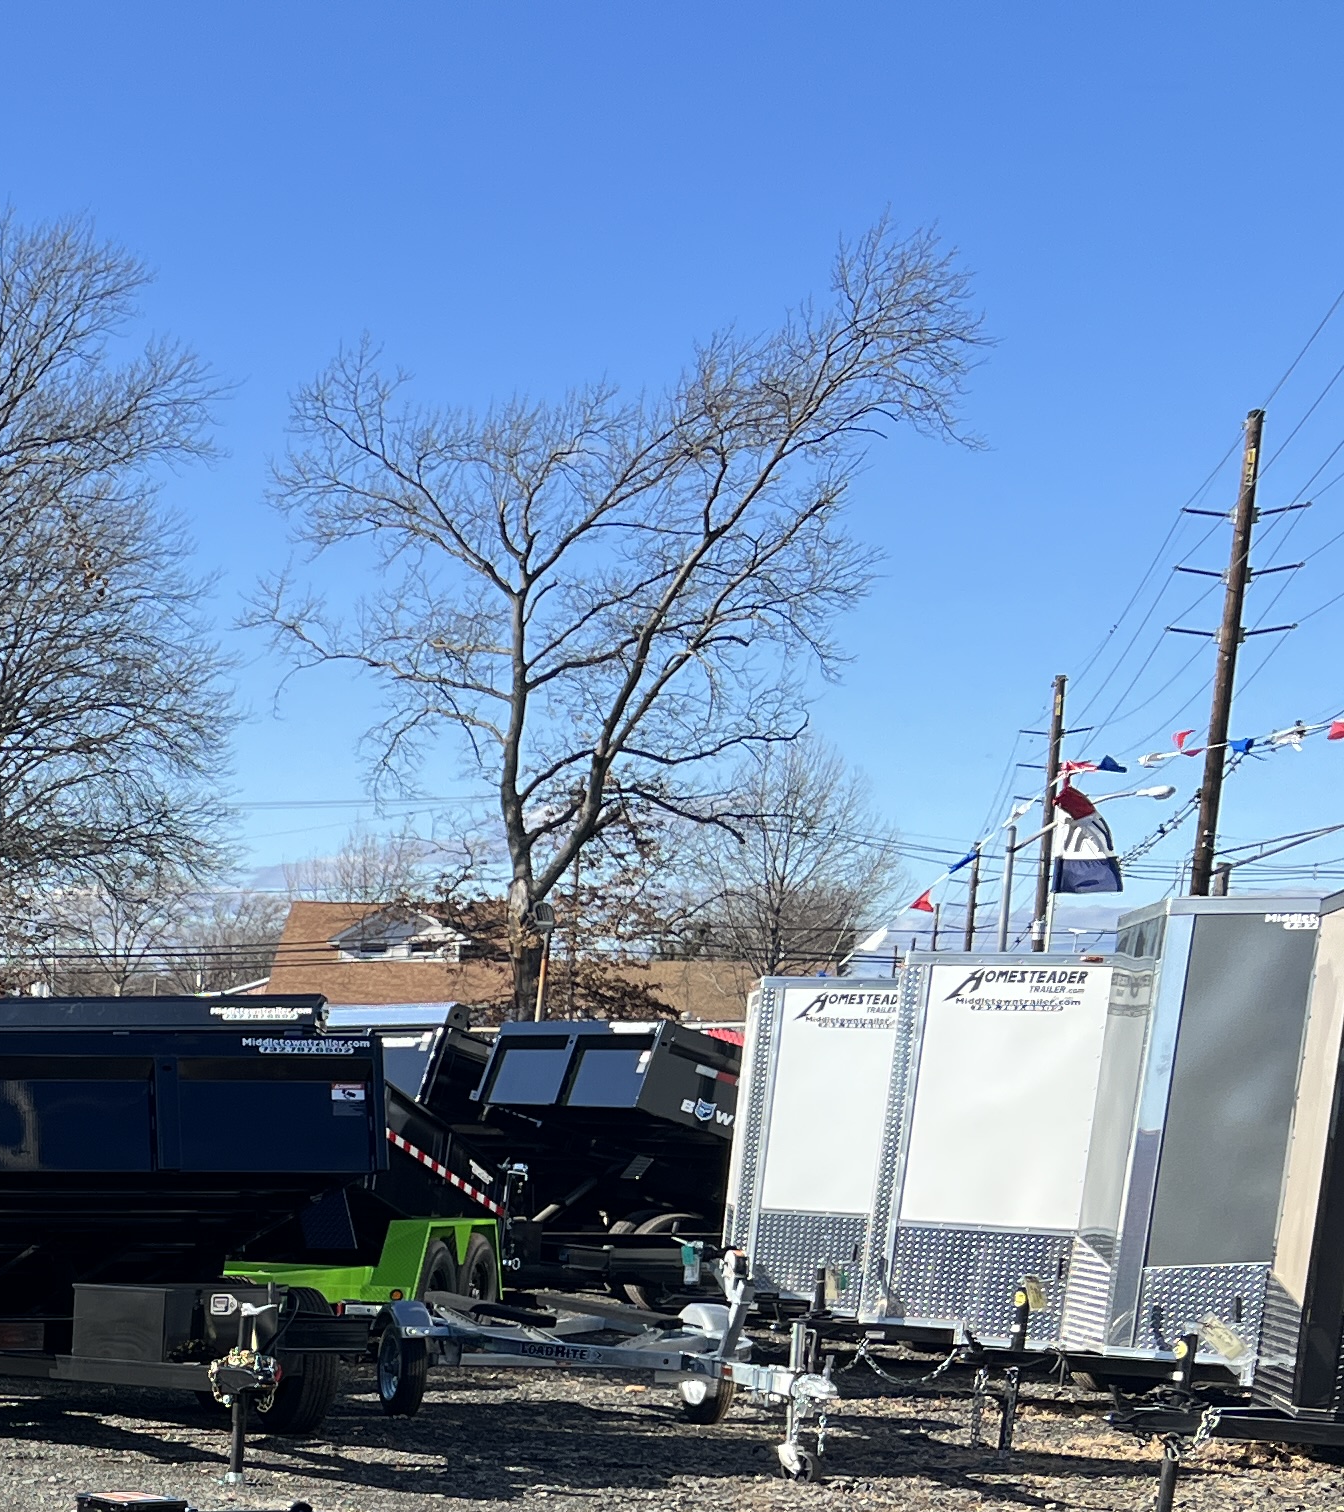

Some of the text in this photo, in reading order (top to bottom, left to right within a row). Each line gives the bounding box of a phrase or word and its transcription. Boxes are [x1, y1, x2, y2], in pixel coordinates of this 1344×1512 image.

[1265, 913, 1320, 923] Middlet
[942, 967, 1089, 1002] HOMESTEADER
[242, 1037, 371, 1049] Middletowntrailer.com
